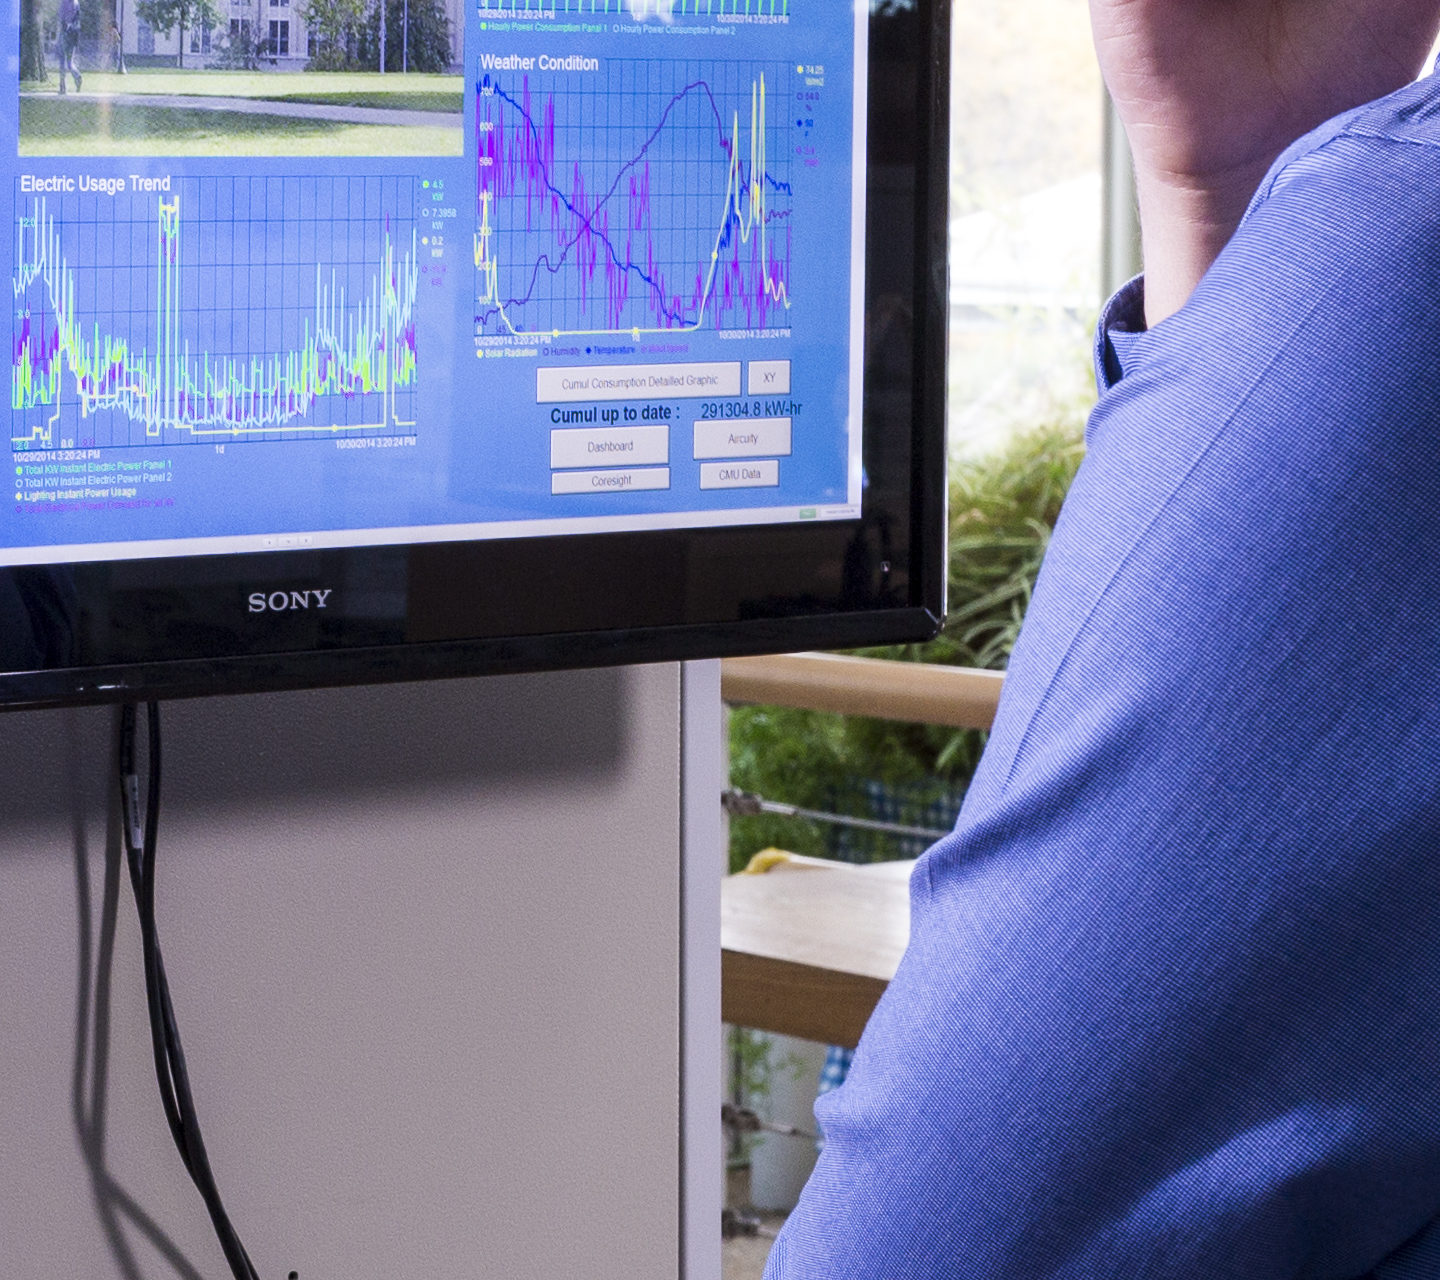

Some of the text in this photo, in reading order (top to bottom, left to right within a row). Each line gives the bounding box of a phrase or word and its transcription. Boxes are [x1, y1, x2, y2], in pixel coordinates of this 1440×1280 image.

[480, 54, 599, 71] Weather Condition
[20, 174, 171, 196] Electric Usage Trend
[485, 348, 538, 358] Solar Radiation
[551, 347, 580, 357] Humidity
[594, 346, 636, 355] Temperature
[562, 378, 590, 391] Cumul
[591, 376, 646, 390] Consumption
[686, 375, 719, 388] Graphic
[763, 372, 776, 383] XY
[551, 408, 597, 424] Cumul
[601, 408, 619, 424] up
[622, 407, 636, 420] to
[639, 406, 671, 421] date
[701, 401, 802, 419] 291304.8 kW-hr
[588, 441, 633, 453] Dashboard
[728, 433, 758, 447] Aircuity
[25, 479, 43, 488] Total
[60, 477, 86, 486] Instant
[88, 475, 116, 485] Electric
[117, 474, 141, 484] Power
[143, 473, 166, 483] Panel
[167, 472, 172, 481] 2
[592, 475, 632, 488] Coresight
[719, 468, 761, 481] CMU Data
[248, 589, 332, 612] SONY
